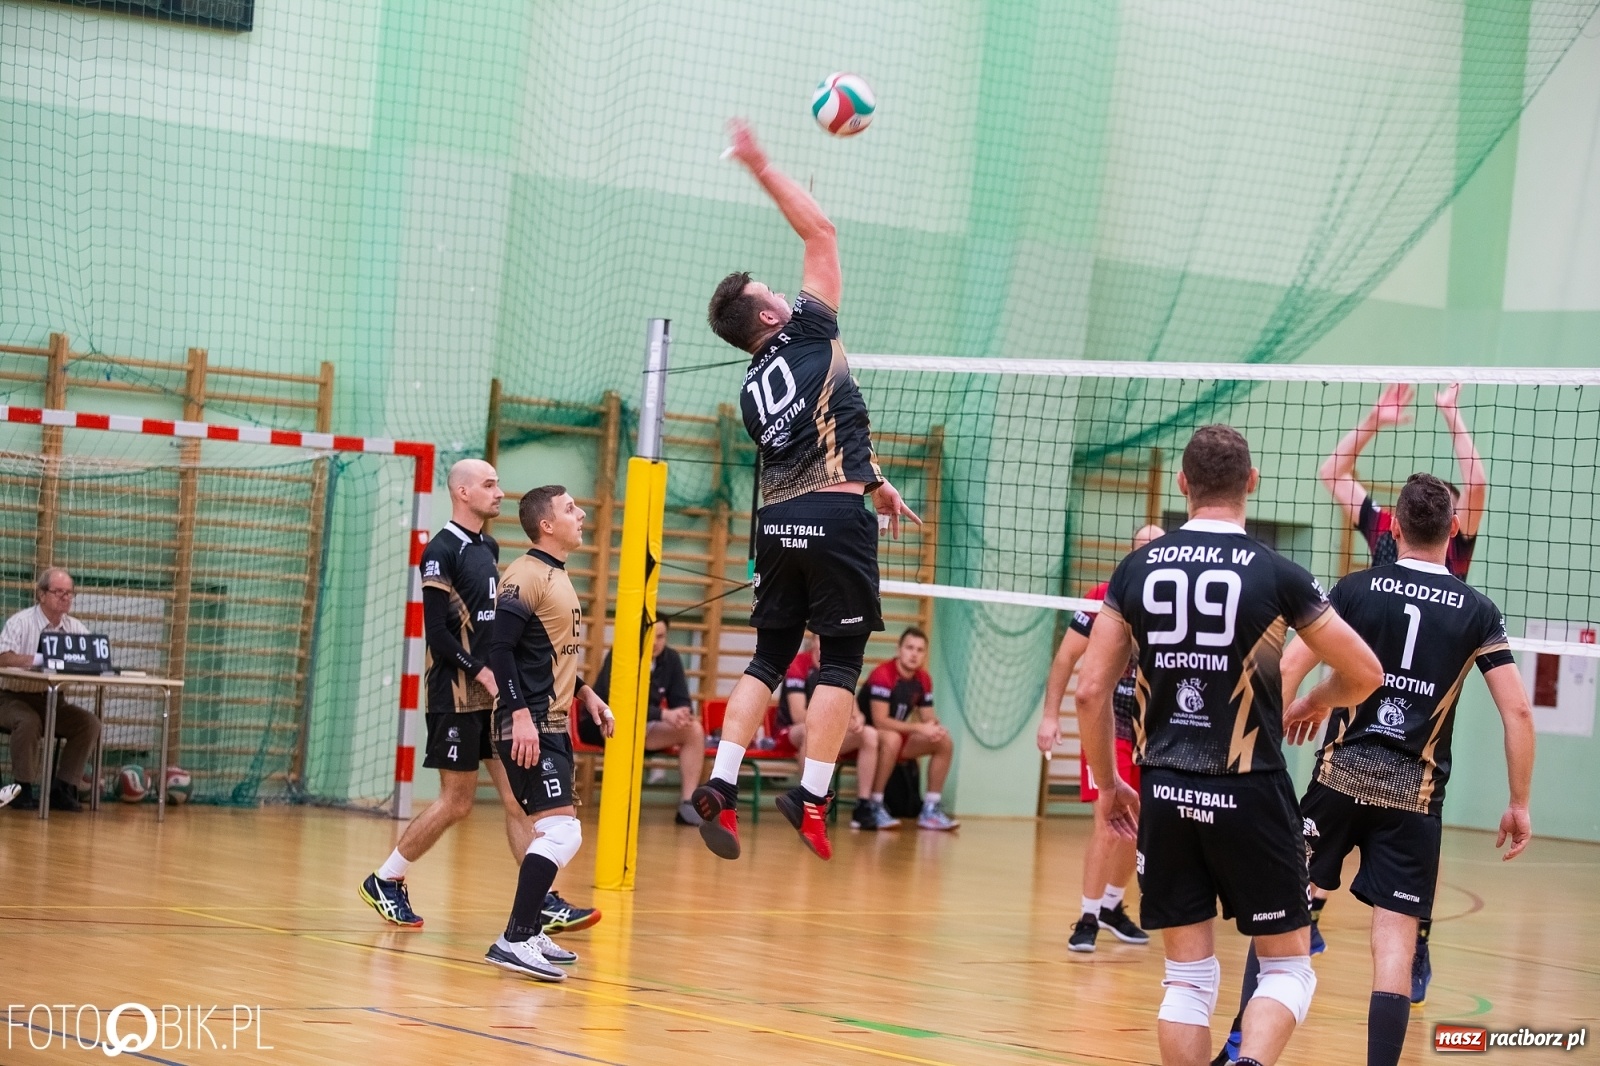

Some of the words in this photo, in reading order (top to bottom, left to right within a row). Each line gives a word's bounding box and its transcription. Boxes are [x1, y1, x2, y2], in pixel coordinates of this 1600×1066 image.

[777, 332, 791, 344] R
[746, 356, 797, 425] 10
[760, 397, 806, 446] AGROTIM
[763, 524, 826, 537] VOLLEYBALL
[780, 537, 808, 549] TEAM
[1146, 546, 1224, 564] SIORAK.
[1231, 548, 1256, 566] W
[1370, 577, 1465, 609] KOŁODZIEJ
[1142, 568, 1242, 647] 99
[841, 616, 863, 625] AGROTIM
[1400, 603, 1421, 670] 1
[43, 635, 59, 656] 17
[64, 635, 73, 650] 0
[79, 637, 87, 651] 0
[92, 638, 109, 659] 16
[560, 644, 580, 656] AGRO
[1155, 652, 1228, 672] AGROTIM
[1382, 673, 1435, 697] ROTIM
[447, 745, 458, 762] 4
[543, 778, 562, 798] 13
[1153, 784, 1237, 809] VOLLEYBALL
[1177, 805, 1214, 824] TEAM
[1393, 890, 1420, 903] AGROTIM
[1252, 909, 1286, 922] AGROTIM
